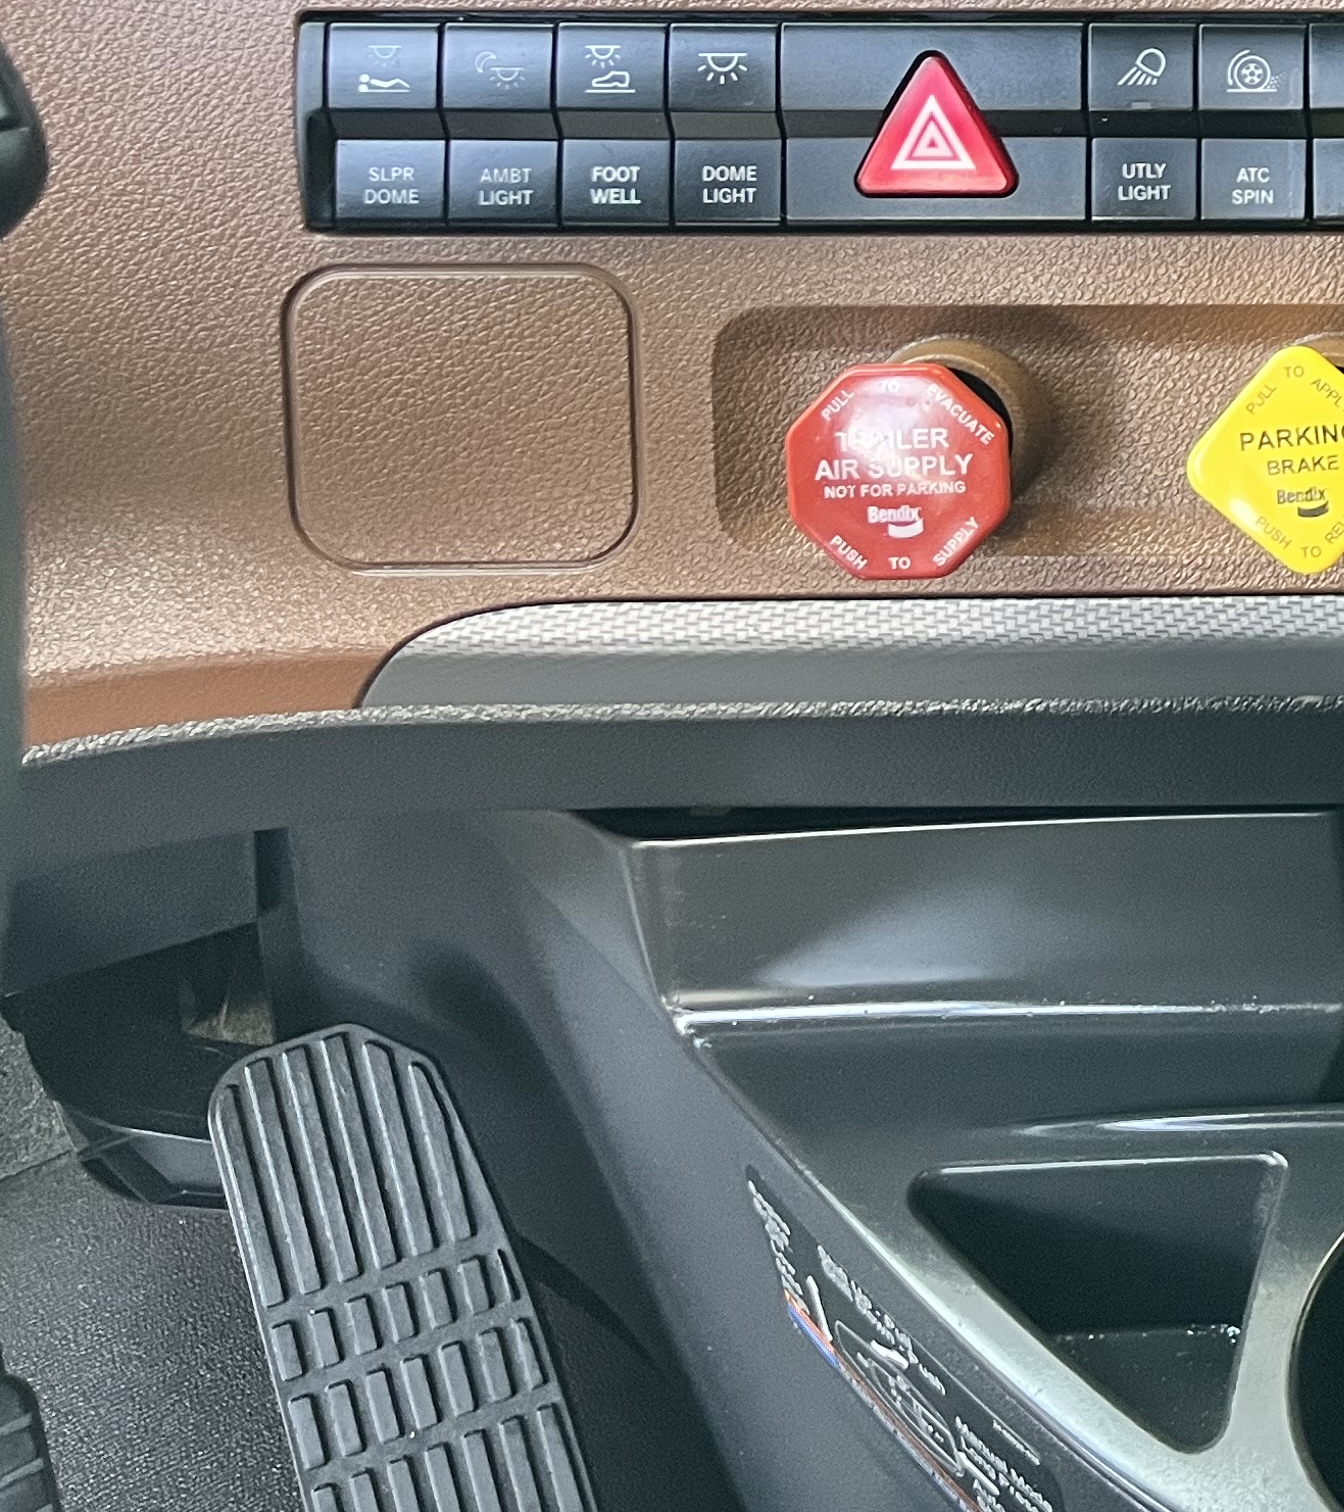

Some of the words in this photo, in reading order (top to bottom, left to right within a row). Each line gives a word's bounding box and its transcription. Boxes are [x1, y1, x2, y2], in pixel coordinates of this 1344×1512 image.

[368, 166, 416, 184] SLPR
[480, 167, 532, 185] AMBT
[591, 165, 641, 183] FOOT
[702, 165, 758, 183] DOME
[1122, 162, 1168, 181] UTLY
[1236, 166, 1271, 184] ATC
[363, 188, 420, 206] DOME
[478, 189, 534, 207] LIGHT
[589, 187, 642, 206] WELL
[702, 187, 757, 205] LIGHT
[1117, 183, 1172, 202] LIGHT
[1231, 187, 1275, 206] SPIN
[1244, 384, 1278, 416] PULL
[1283, 364, 1305, 379] TO
[820, 389, 856, 422] PULL
[881, 380, 900, 393] TO
[926, 382, 995, 447] EVACUATE
[834, 427, 950, 454] TILER
[814, 458, 861, 481] AIR
[867, 452, 974, 480] SUPPLY
[1266, 454, 1341, 477] BRAKE
[823, 484, 856, 500] NOT
[860, 483, 894, 498] FOR
[896, 480, 967, 497] PARKING
[1276, 486, 1327, 505] Bendix
[866, 504, 922, 525] Bendix
[829, 534, 869, 571] PUSH
[888, 556, 912, 571] TO
[932, 515, 980, 568] SUPPLY
[1254, 515, 1293, 551] PUSH
[1300, 545, 1322, 560] TO
